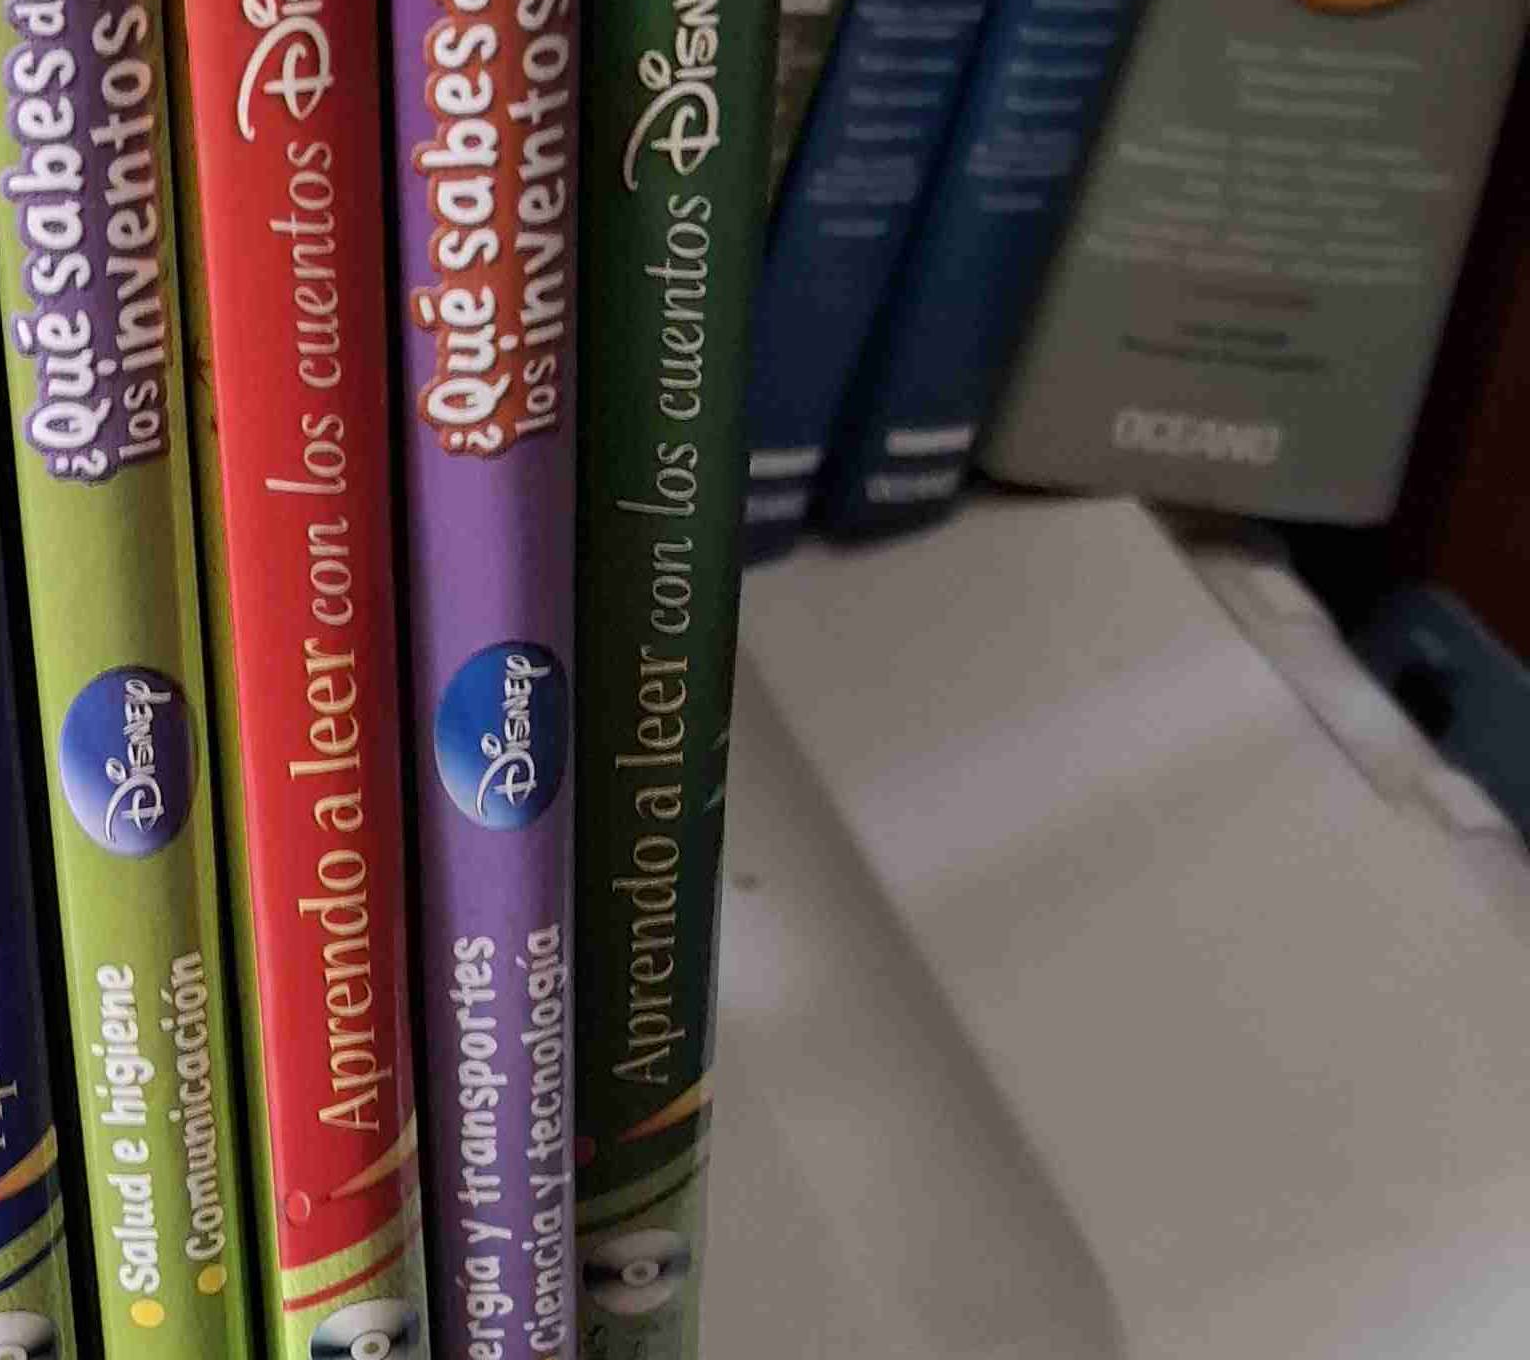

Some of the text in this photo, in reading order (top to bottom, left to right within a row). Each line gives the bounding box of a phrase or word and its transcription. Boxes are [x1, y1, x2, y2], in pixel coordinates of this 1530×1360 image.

[9, 49, 91, 292] sabes
[421, 22, 501, 270] sabes
[16, 309, 110, 479] ¿Qué
[119, 381, 163, 461] los
[420, 286, 510, 453] ¿Qué
[516, 354, 561, 432] los
[265, 140, 394, 1132] Aprendo a leer con los cuentos
[610, 193, 713, 1085] Aprendo a leer con los cuentos
[94, 963, 160, 1295] Salud e higiene
[160, 948, 227, 1262] Comunicación
[449, 934, 502, 1209] transportes
[515, 924, 570, 1352] Ciencia y tecnología
[460, 1206, 513, 1240] y
